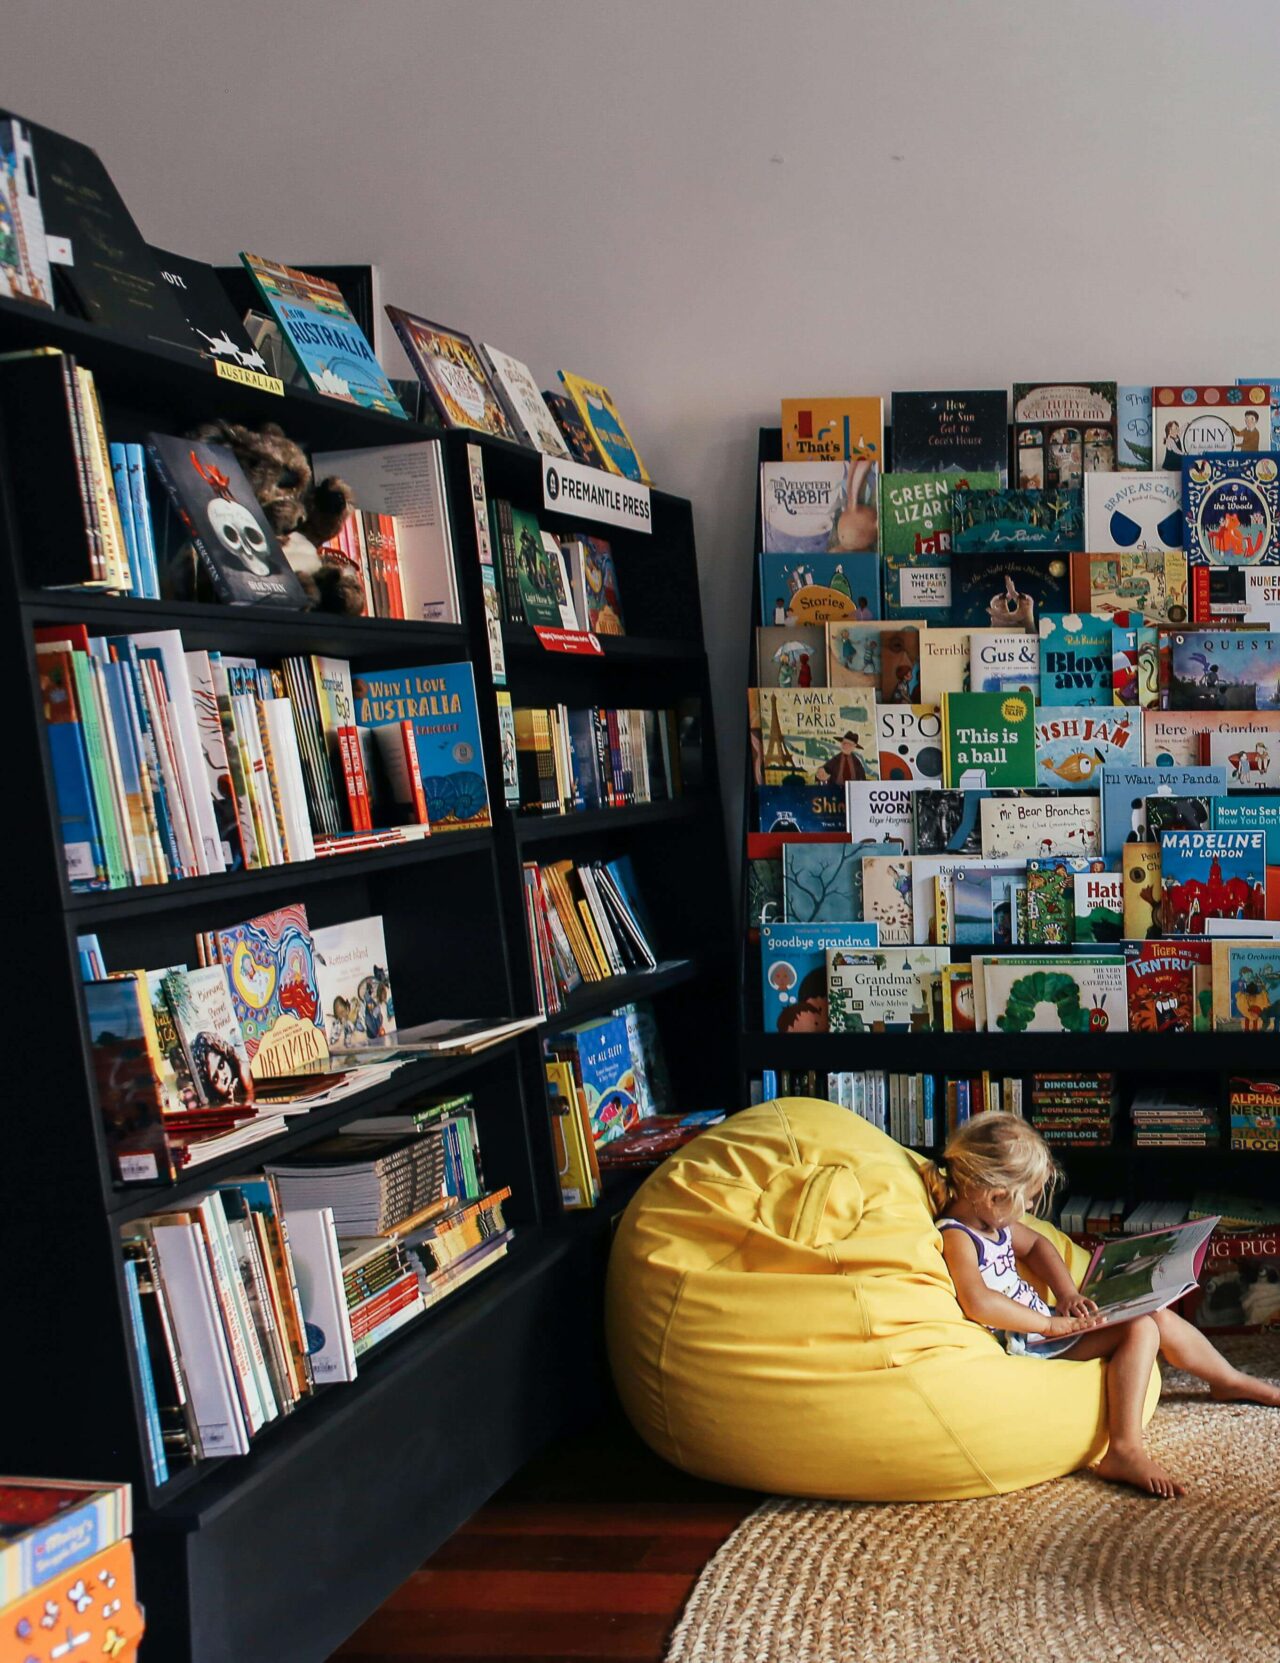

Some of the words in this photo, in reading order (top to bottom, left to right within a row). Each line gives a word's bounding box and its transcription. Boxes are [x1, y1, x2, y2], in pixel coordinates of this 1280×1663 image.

[287, 321, 374, 363] AUSTRALIA
[219, 363, 283, 393] AUSTRALIAN
[946, 400, 966, 410] How
[939, 412, 954, 422] the
[958, 412, 975, 422] Sun
[940, 424, 958, 434] Got
[960, 424, 970, 433] to
[1190, 427, 1228, 442] TINY
[796, 440, 840, 454] That's
[954, 436, 983, 446] House
[782, 480, 831, 490] VELVETEEN
[561, 476, 621, 511] FREMANTLE
[622, 497, 649, 520] PRESS
[890, 480, 948, 506] GREEN
[1104, 486, 1136, 511] BRAVE
[1138, 482, 1152, 493] AS
[1154, 484, 1179, 500] CAN
[1220, 494, 1237, 504] Deep
[1239, 494, 1248, 502] in
[774, 490, 831, 515] RABBIT
[1213, 502, 1225, 510] the
[1226, 502, 1253, 511] Woods
[911, 580, 925, 588] THE
[926, 580, 947, 588] PAIR?
[800, 596, 845, 610] Stories
[814, 610, 829, 621] for
[1204, 640, 1276, 650] QUEST
[980, 646, 1014, 664] Gus
[1018, 645, 1036, 664] &
[369, 682, 401, 698] WHY
[405, 679, 411, 695] I
[416, 677, 446, 694] LOVE
[793, 694, 801, 705] A
[804, 693, 834, 705] WALK
[361, 694, 462, 723] AUSTRALIA
[796, 713, 836, 728] PARIS
[956, 728, 998, 743] This
[1002, 728, 1018, 743] is
[1083, 719, 1131, 749] JAM
[957, 752, 968, 764] a
[972, 749, 1008, 764] ball
[1160, 774, 1178, 784] Mr
[1000, 809, 1012, 820] Mr
[1018, 804, 1043, 820] Bear
[1045, 804, 1091, 818] Branches
[1218, 807, 1238, 816] Now
[1240, 807, 1256, 816] You
[1258, 807, 1276, 816] See
[1218, 816, 1237, 825] Now
[1240, 816, 1257, 825] You
[1162, 833, 1262, 848] MADELINE
[1181, 850, 1193, 858] IN
[1199, 850, 1244, 858] LONDON
[768, 937, 814, 950] goodbye
[818, 937, 871, 948] grandma
[1232, 952, 1245, 960] The
[854, 972, 921, 986] Grandma's
[868, 985, 908, 997] House
[259, 1028, 320, 1078] DREAMERS
[1044, 1081, 1098, 1089] DINOBLOCK
[1044, 1131, 1098, 1139] DINOBLOCK
[1241, 1241, 1276, 1255] PUG
